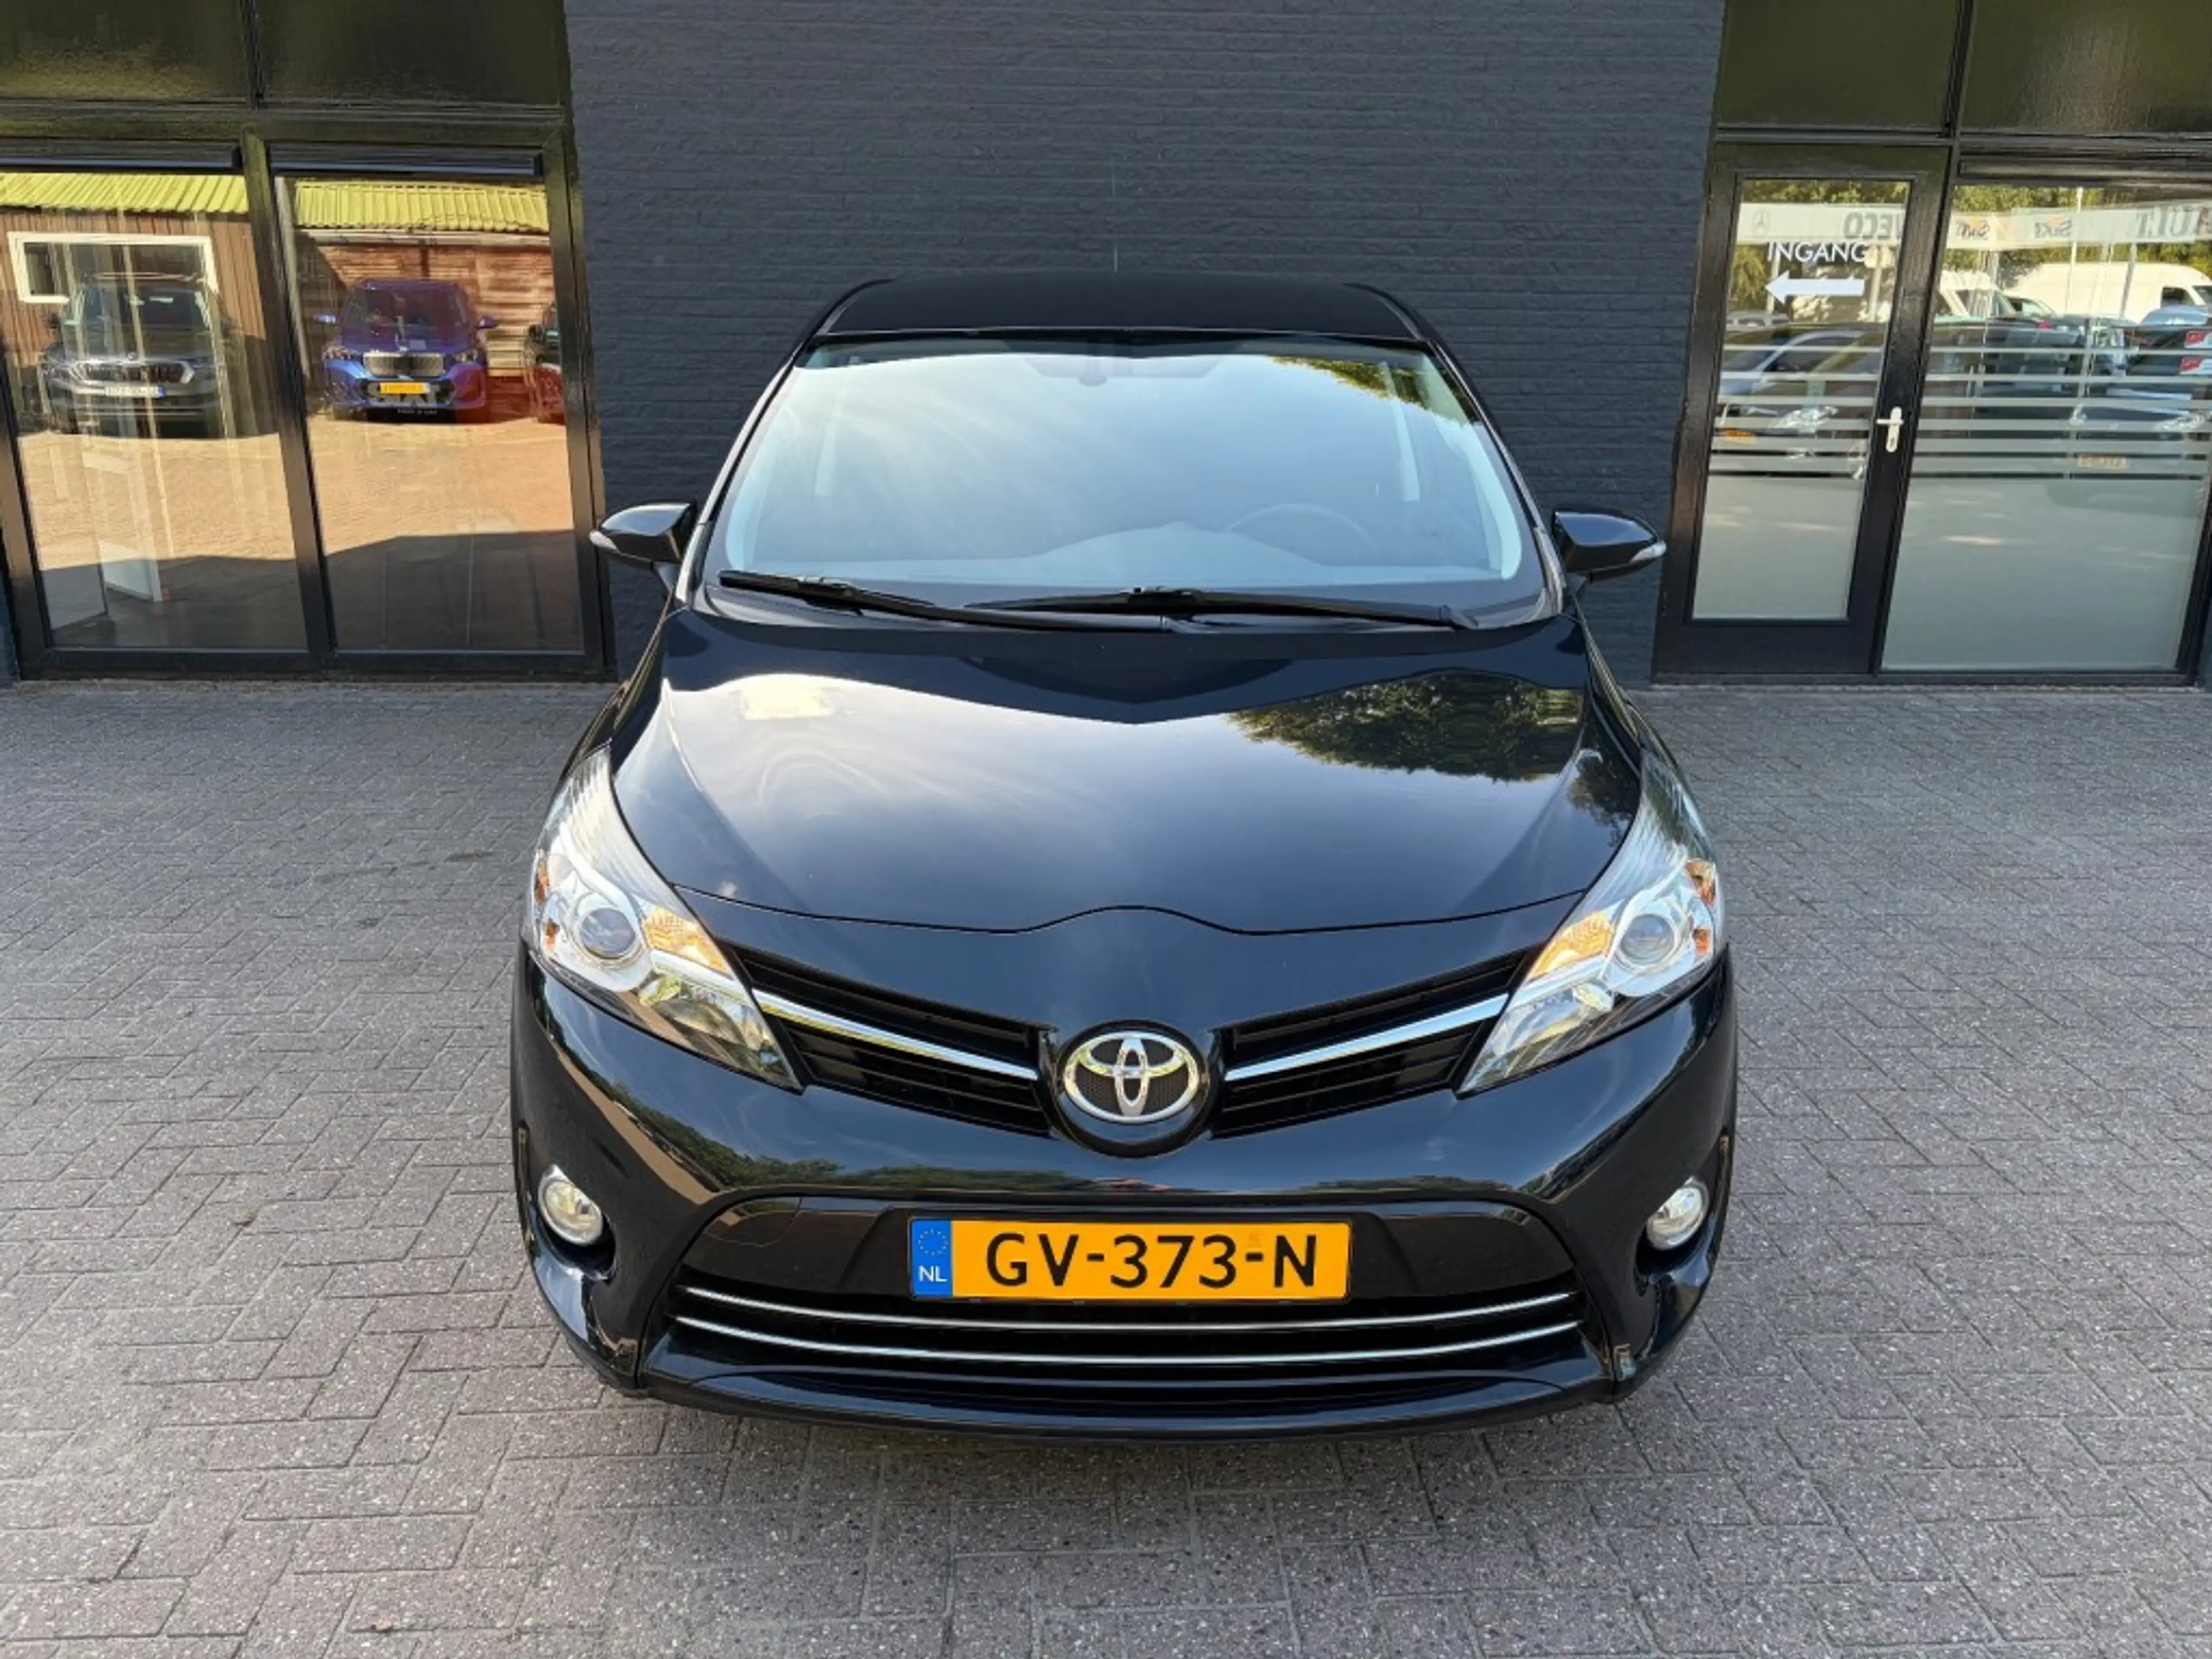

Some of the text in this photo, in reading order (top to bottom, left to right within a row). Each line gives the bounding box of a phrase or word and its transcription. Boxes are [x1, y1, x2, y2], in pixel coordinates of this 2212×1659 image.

[1766, 241, 1867, 262] INGANG
[986, 1232, 1317, 1289] GV-373-N
[919, 1266, 947, 1282] NL
